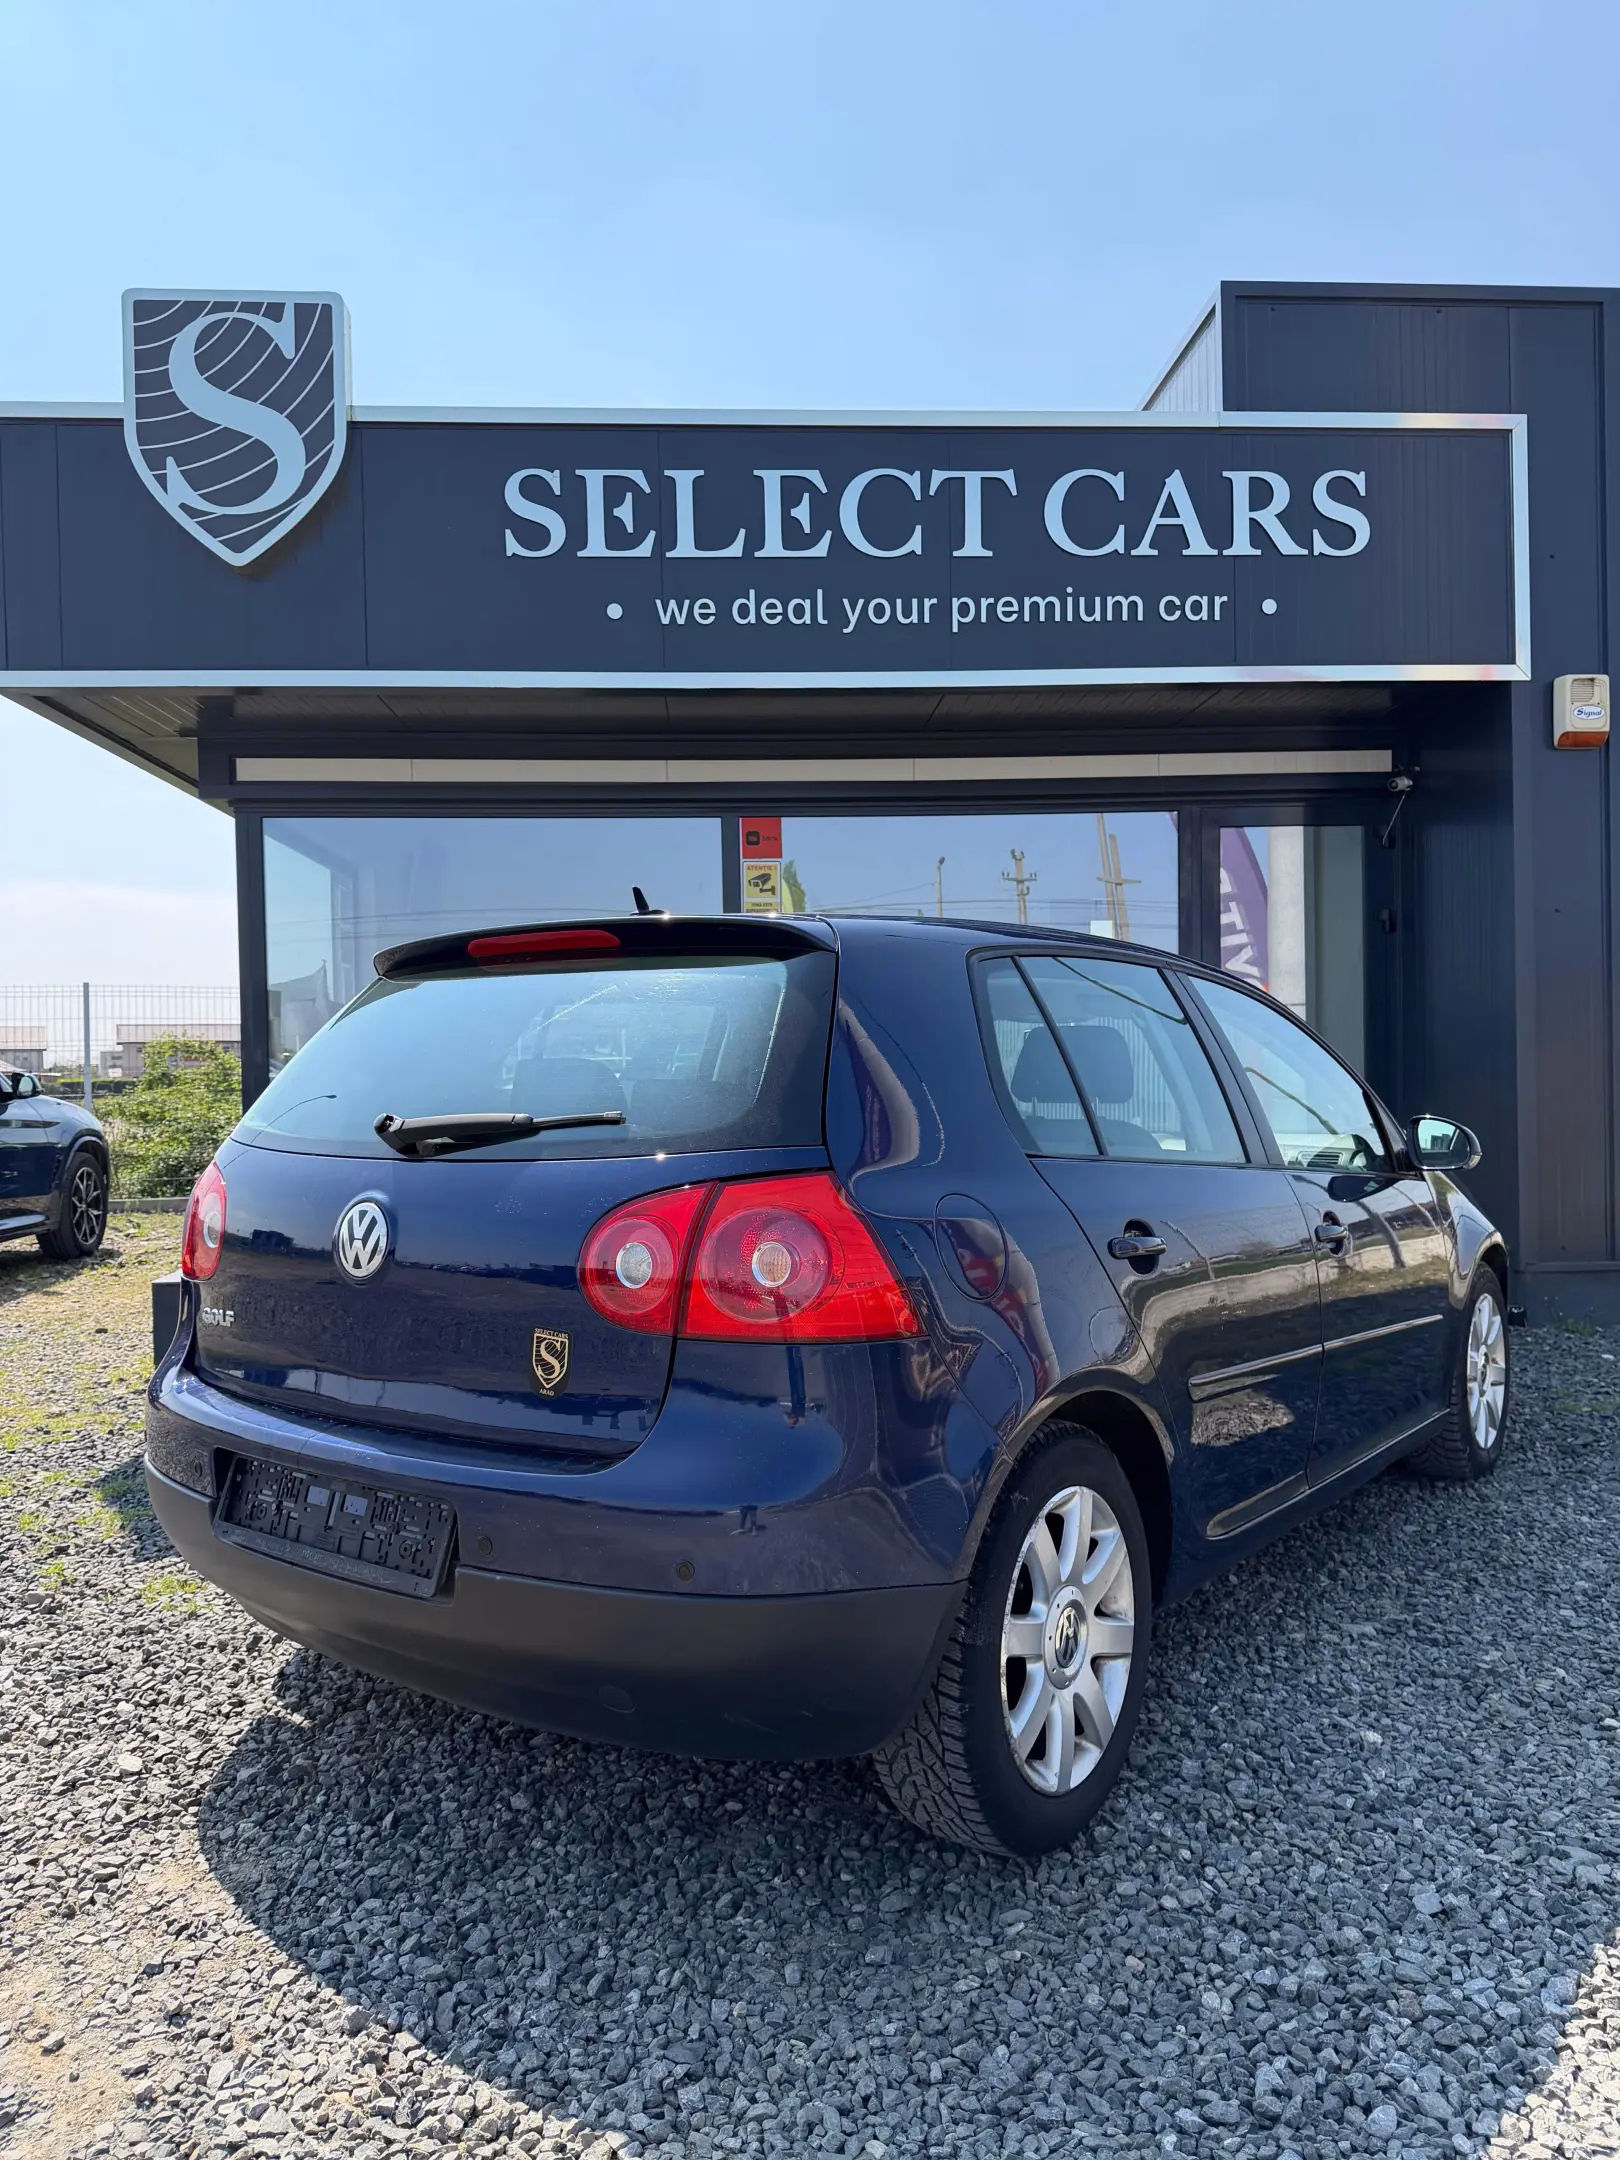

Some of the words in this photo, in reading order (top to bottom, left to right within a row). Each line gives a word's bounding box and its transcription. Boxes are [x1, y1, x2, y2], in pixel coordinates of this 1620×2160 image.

[504, 468, 1018, 558] SELECT
[1044, 468, 1371, 557] CARS
[655, 598, 716, 625] we
[731, 588, 828, 625] deal
[842, 597, 938, 634] your
[951, 586, 1144, 633] premium
[1158, 594, 1228, 621] car
[1577, 708, 1603, 718] Signal
[201, 1306, 236, 1328] GOLF
